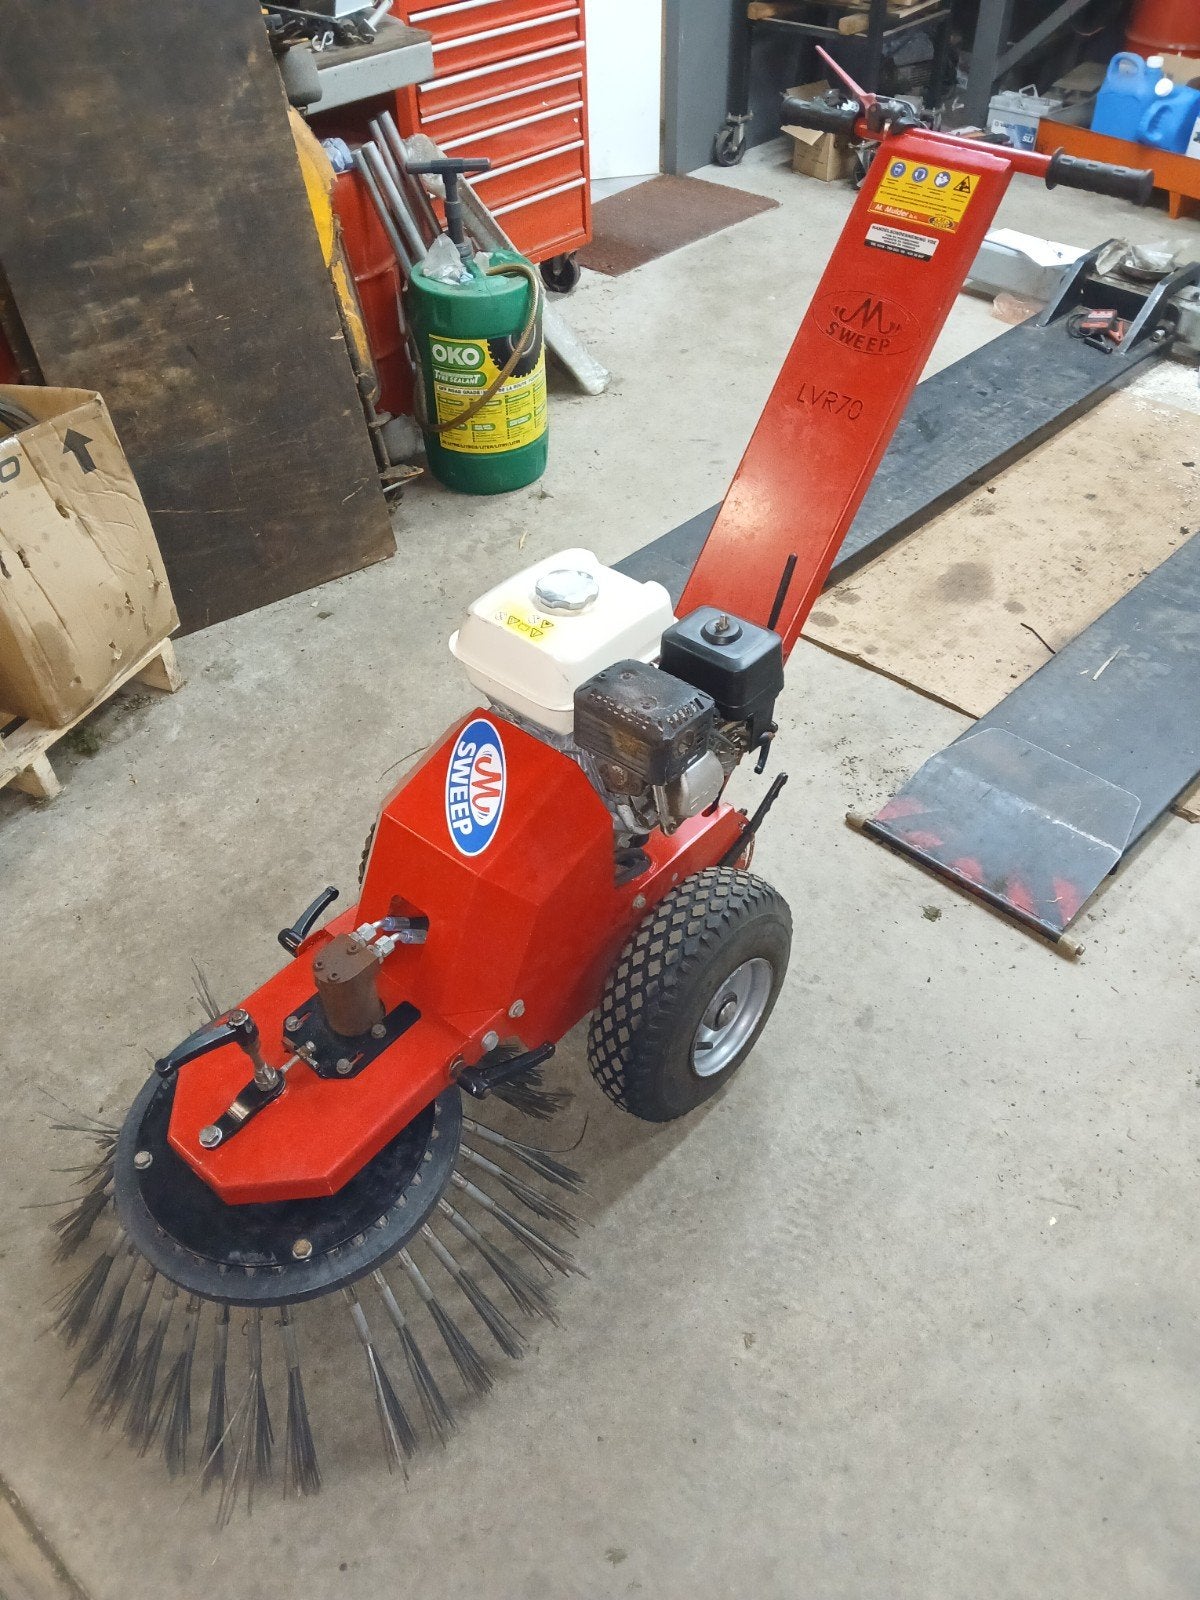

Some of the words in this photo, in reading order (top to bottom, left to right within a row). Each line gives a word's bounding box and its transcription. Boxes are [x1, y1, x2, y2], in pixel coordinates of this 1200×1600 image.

[884, 206, 909, 217] Mulder
[826, 321, 891, 353] SWEEP
[432, 344, 480, 366] OKO
[796, 382, 864, 421] LVR70
[450, 741, 476, 835] SWEEP
[471, 755, 502, 813] M
